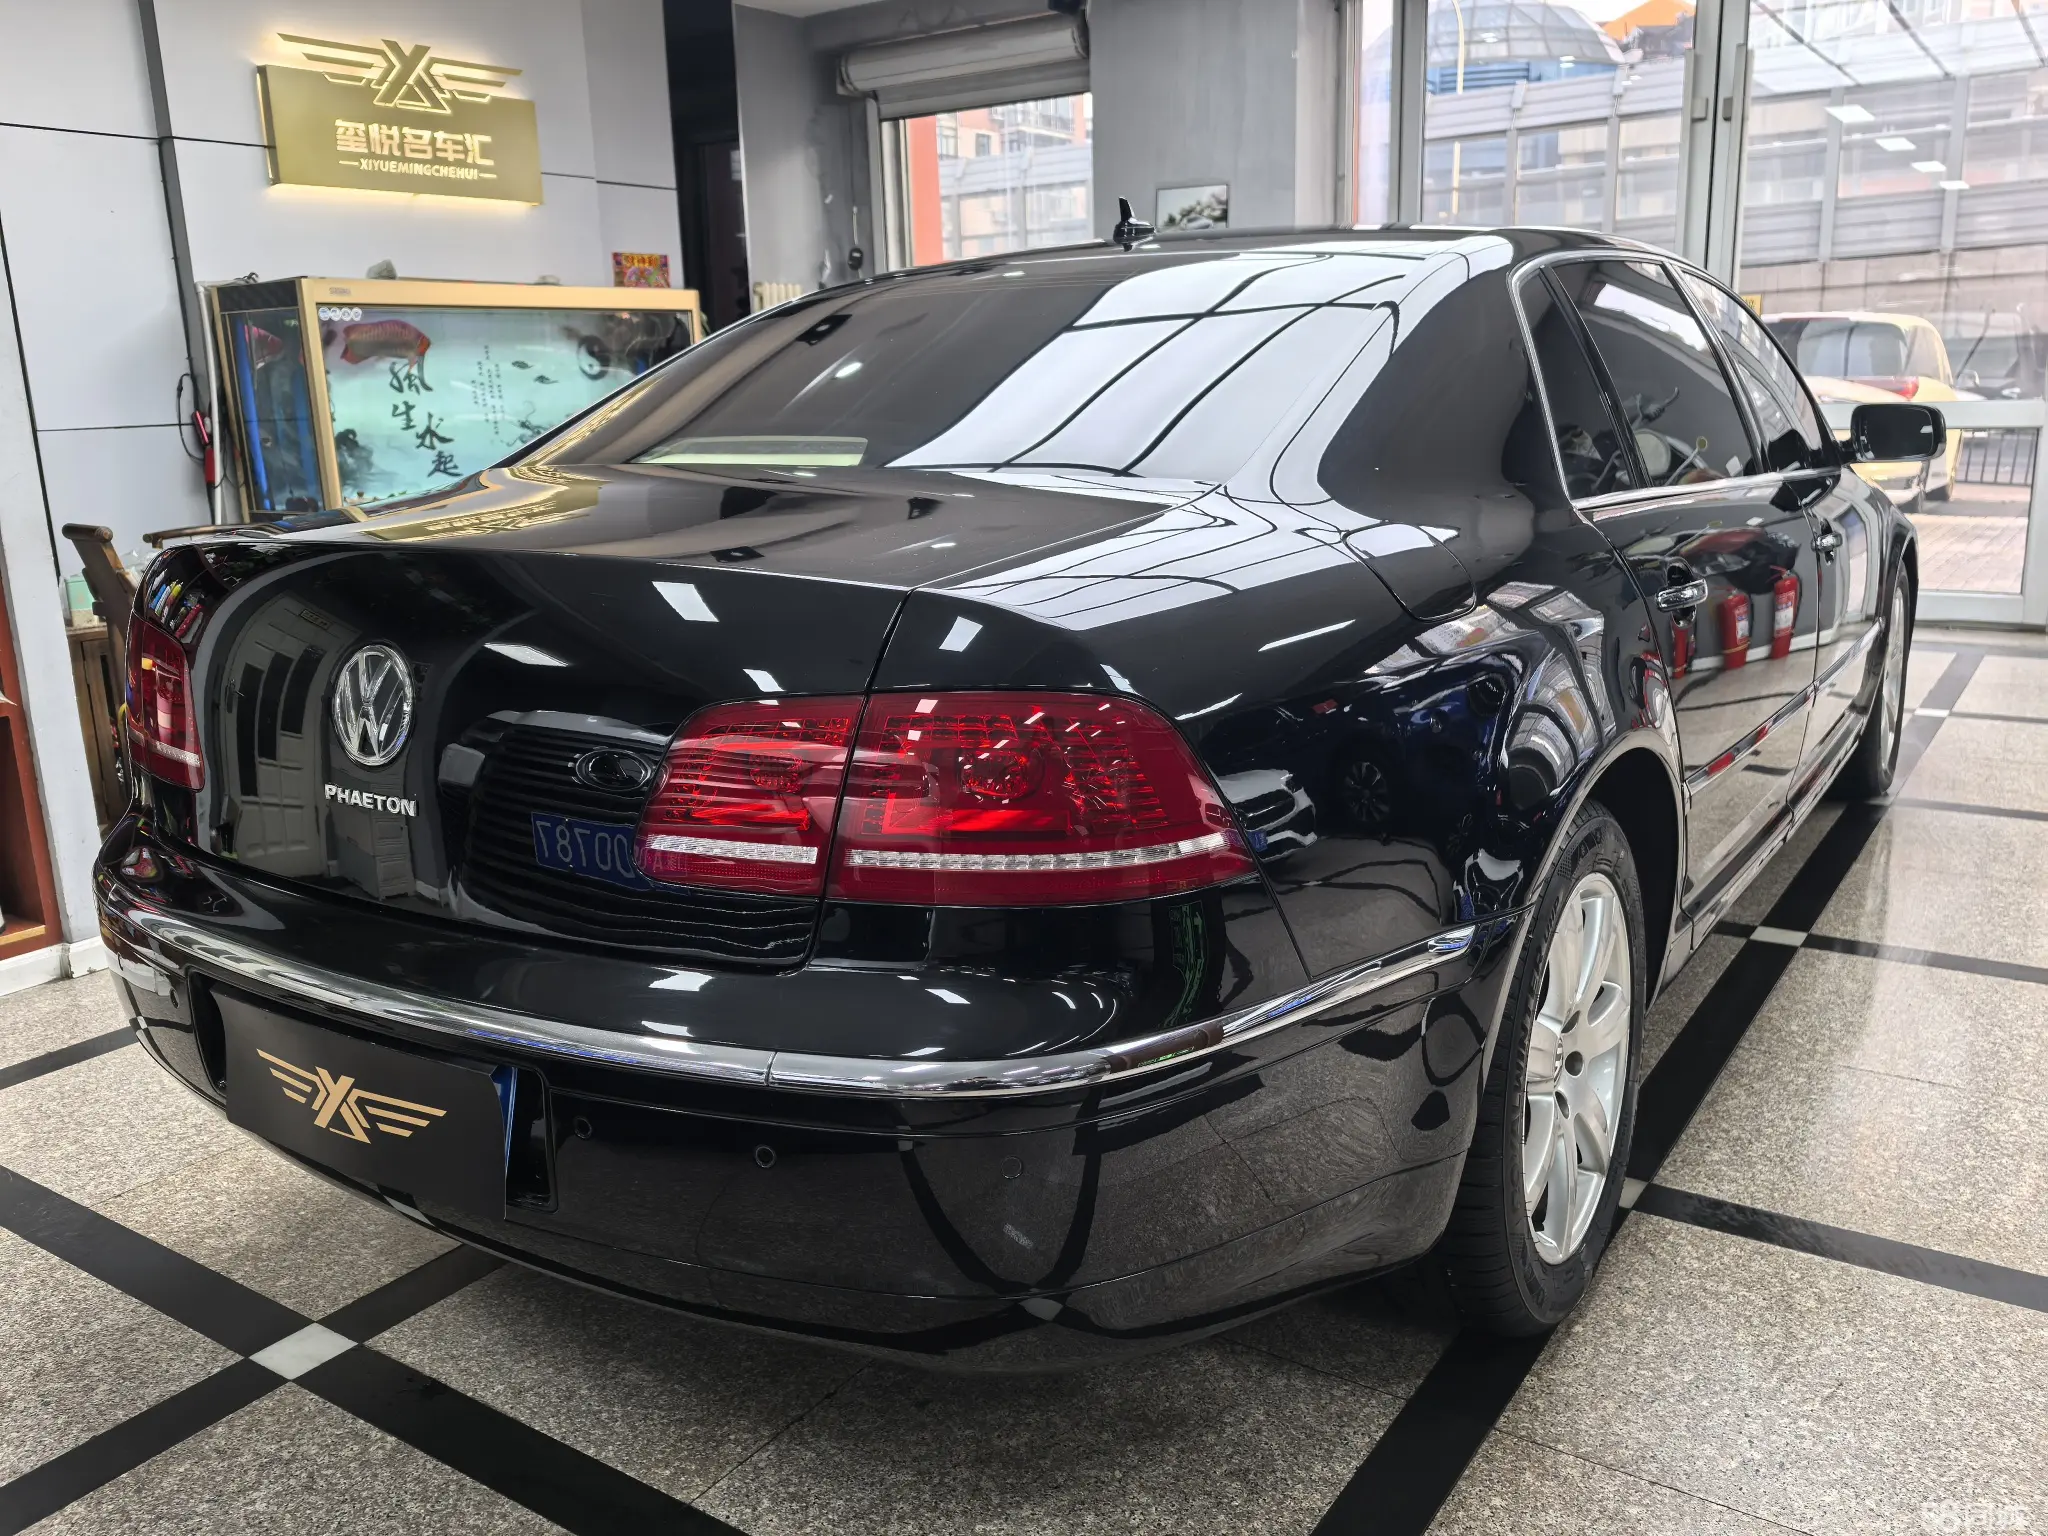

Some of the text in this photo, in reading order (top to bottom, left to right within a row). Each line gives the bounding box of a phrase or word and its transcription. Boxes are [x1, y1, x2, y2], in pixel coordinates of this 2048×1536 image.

[335, 119, 495, 166] 玺悦名车汇
[359, 158, 479, 180] XIYUEMINGCHEHUI
[324, 783, 418, 817] PHAETON
